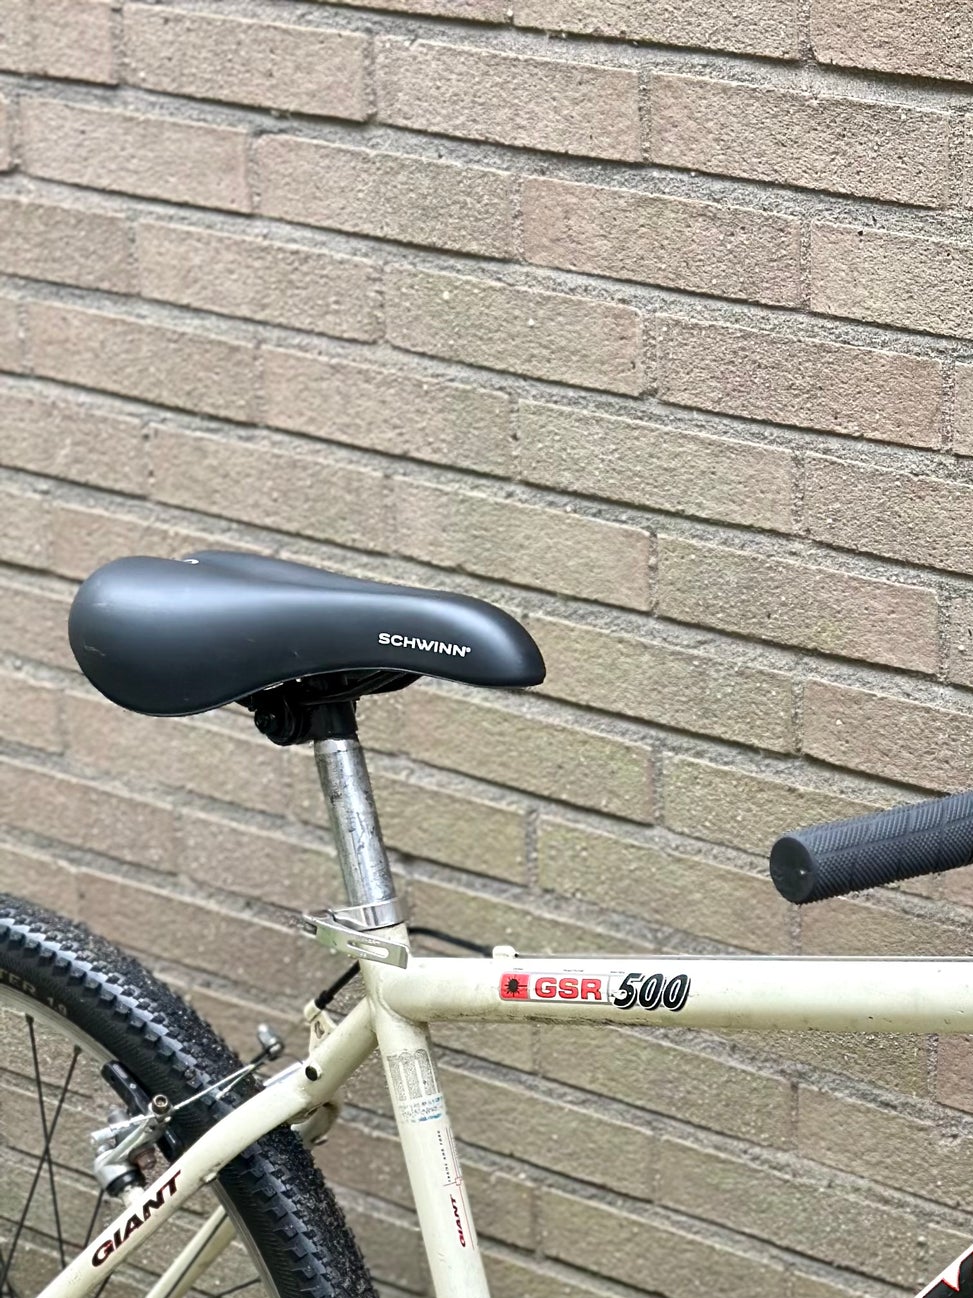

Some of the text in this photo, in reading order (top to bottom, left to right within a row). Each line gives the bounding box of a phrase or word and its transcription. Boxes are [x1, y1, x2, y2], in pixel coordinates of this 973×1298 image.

[534, 973, 691, 1012] GSR 500
[91, 1168, 182, 1267] GIANT
[449, 1193, 466, 1248] GIANT
